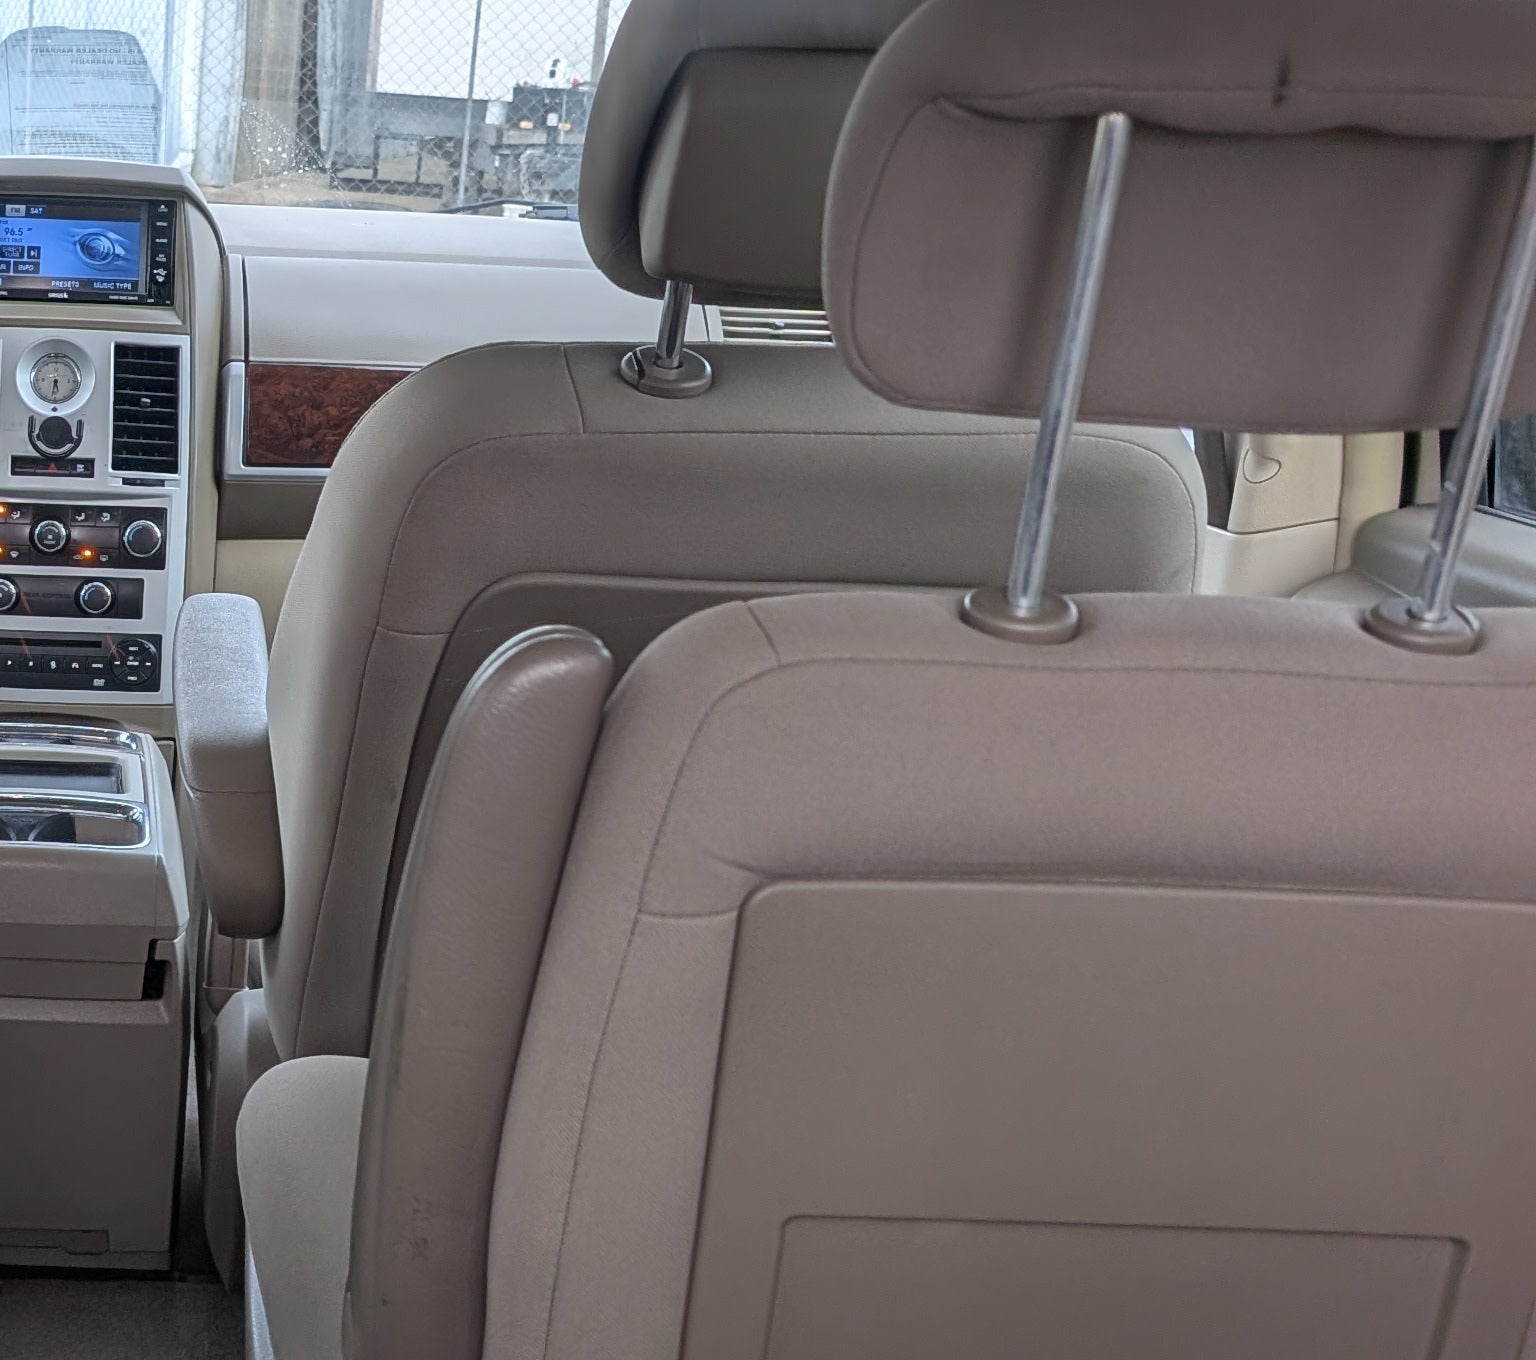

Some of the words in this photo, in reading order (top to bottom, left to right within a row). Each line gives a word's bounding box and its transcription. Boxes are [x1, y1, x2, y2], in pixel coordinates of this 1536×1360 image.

[30, 207, 43, 215] SAT
[4, 227, 24, 237] 96.5
[51, 280, 80, 288] PRESETS
[116, 282, 132, 290] TYPE
